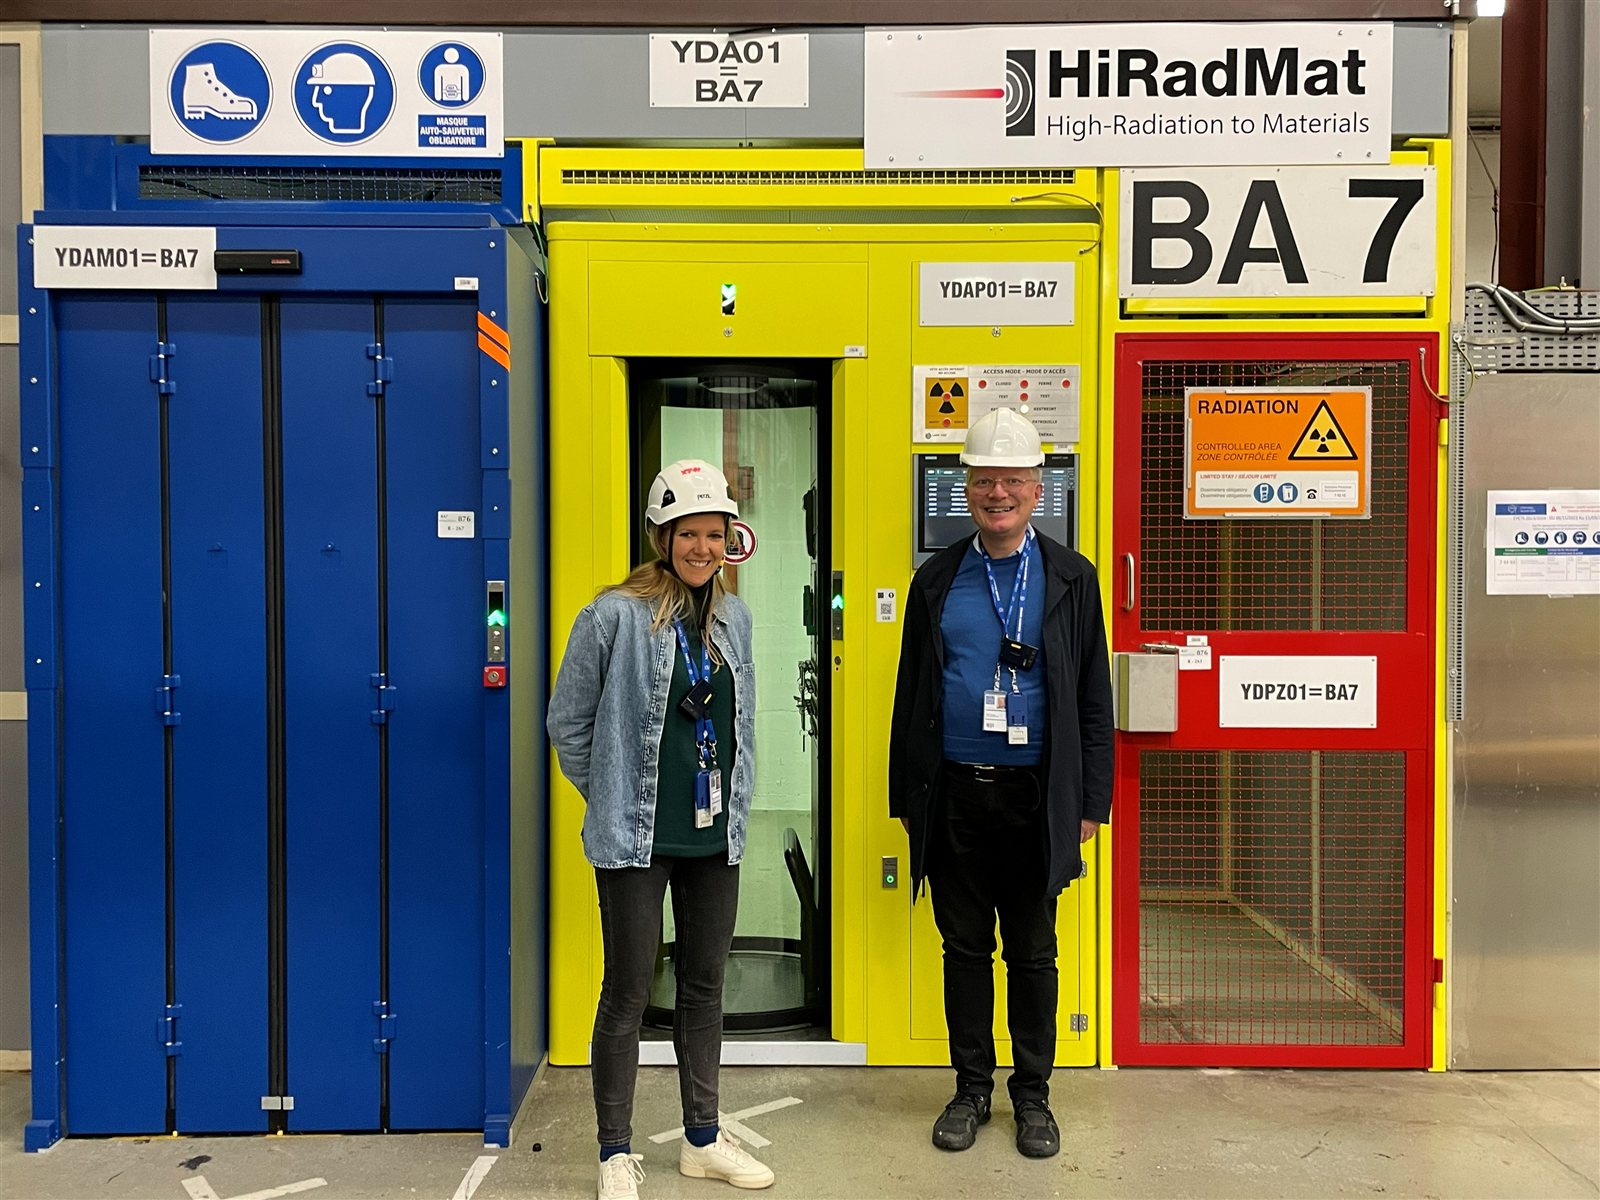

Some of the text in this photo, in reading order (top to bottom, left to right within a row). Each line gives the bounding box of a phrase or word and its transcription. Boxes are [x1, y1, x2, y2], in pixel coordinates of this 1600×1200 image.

[671, 40, 779, 64] YDA01
[1049, 47, 1366, 99] HiRadMat
[696, 79, 763, 102] BA7
[436, 117, 468, 126] MASQUE
[1048, 112, 1369, 142] High-Radiation to Materials
[420, 127, 485, 136] AUTO-SAUVETEUR
[428, 137, 476, 145] OBLIGATOIRE
[1132, 179, 1424, 285] BA 7
[1198, 399, 1299, 415] RADIATION
[1196, 443, 1256, 451] CONTROLLED
[1196, 451, 1278, 461] ZONE CONTRÔLÉE
